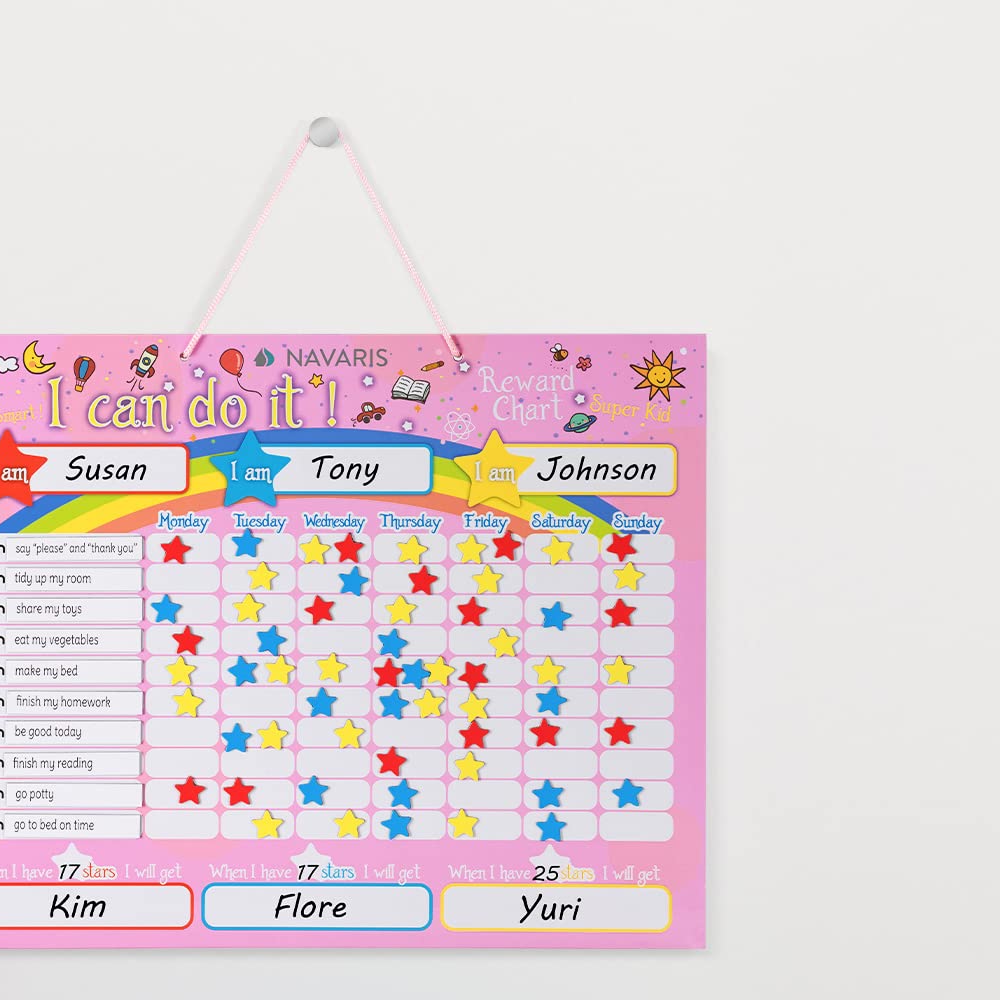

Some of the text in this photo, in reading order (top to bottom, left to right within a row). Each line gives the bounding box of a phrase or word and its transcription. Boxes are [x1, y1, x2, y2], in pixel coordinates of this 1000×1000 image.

[287, 348, 388, 367] NAVARIS
[478, 365, 574, 393] Reward
[48, 376, 66, 428] I
[87, 389, 173, 432] can
[188, 376, 248, 428] do
[270, 374, 304, 428] it
[493, 392, 564, 425] Chart
[589, 394, 672, 423] Super Kid
[1, 464, 29, 484] am
[65, 455, 147, 481] Susan
[231, 455, 379, 486] I am Tony
[474, 456, 657, 484] I am Johnson
[158, 512, 662, 534] Monday Tuesday Wednesday Thursday Friday Saturday Sunday
[16, 545, 30, 556] say
[70, 543, 85, 553] and
[15, 572, 32, 586] tidy
[35, 574, 47, 586] up
[50, 574, 63, 586] my
[67, 575, 92, 583] room
[17, 603, 42, 614] share
[45, 605, 59, 617] my
[62, 603, 82, 617] toys
[15, 635, 29, 645] eat
[32, 636, 46, 648] my
[49, 634, 98, 648] vegetables
[15, 665, 41, 676] make
[43, 667, 58, 678] my
[60, 665, 78, 676] bed
[17, 695, 41, 707] finish
[43, 698, 58, 710] my
[61, 697, 111, 707] homework
[15, 726, 26, 736] be
[29, 726, 52, 739] good
[54, 726, 82, 740] today
[13, 757, 37, 768] finish
[41, 759, 55, 771] my
[58, 758, 93, 771] reading
[16, 789, 28, 801] go
[30, 788, 54, 802] potty
[14, 820, 25, 832] go
[28, 820, 37, 829] to
[40, 819, 57, 830] bed
[60, 821, 71, 830] on
[74, 820, 94, 830] time
[12, 864, 16, 879] I
[22, 865, 52, 880] have
[59, 864, 80, 879] 17
[83, 862, 116, 878] stars
[125, 864, 130, 879] I
[135, 864, 156, 879] will
[160, 863, 182, 884] get
[209, 863, 420, 885] When I have 17 stars I will get
[448, 864, 660, 886] When I have 25 stars I will get
[50, 894, 106, 918] Kim
[275, 892, 347, 919] Flore
[520, 894, 582, 924] Yuri
